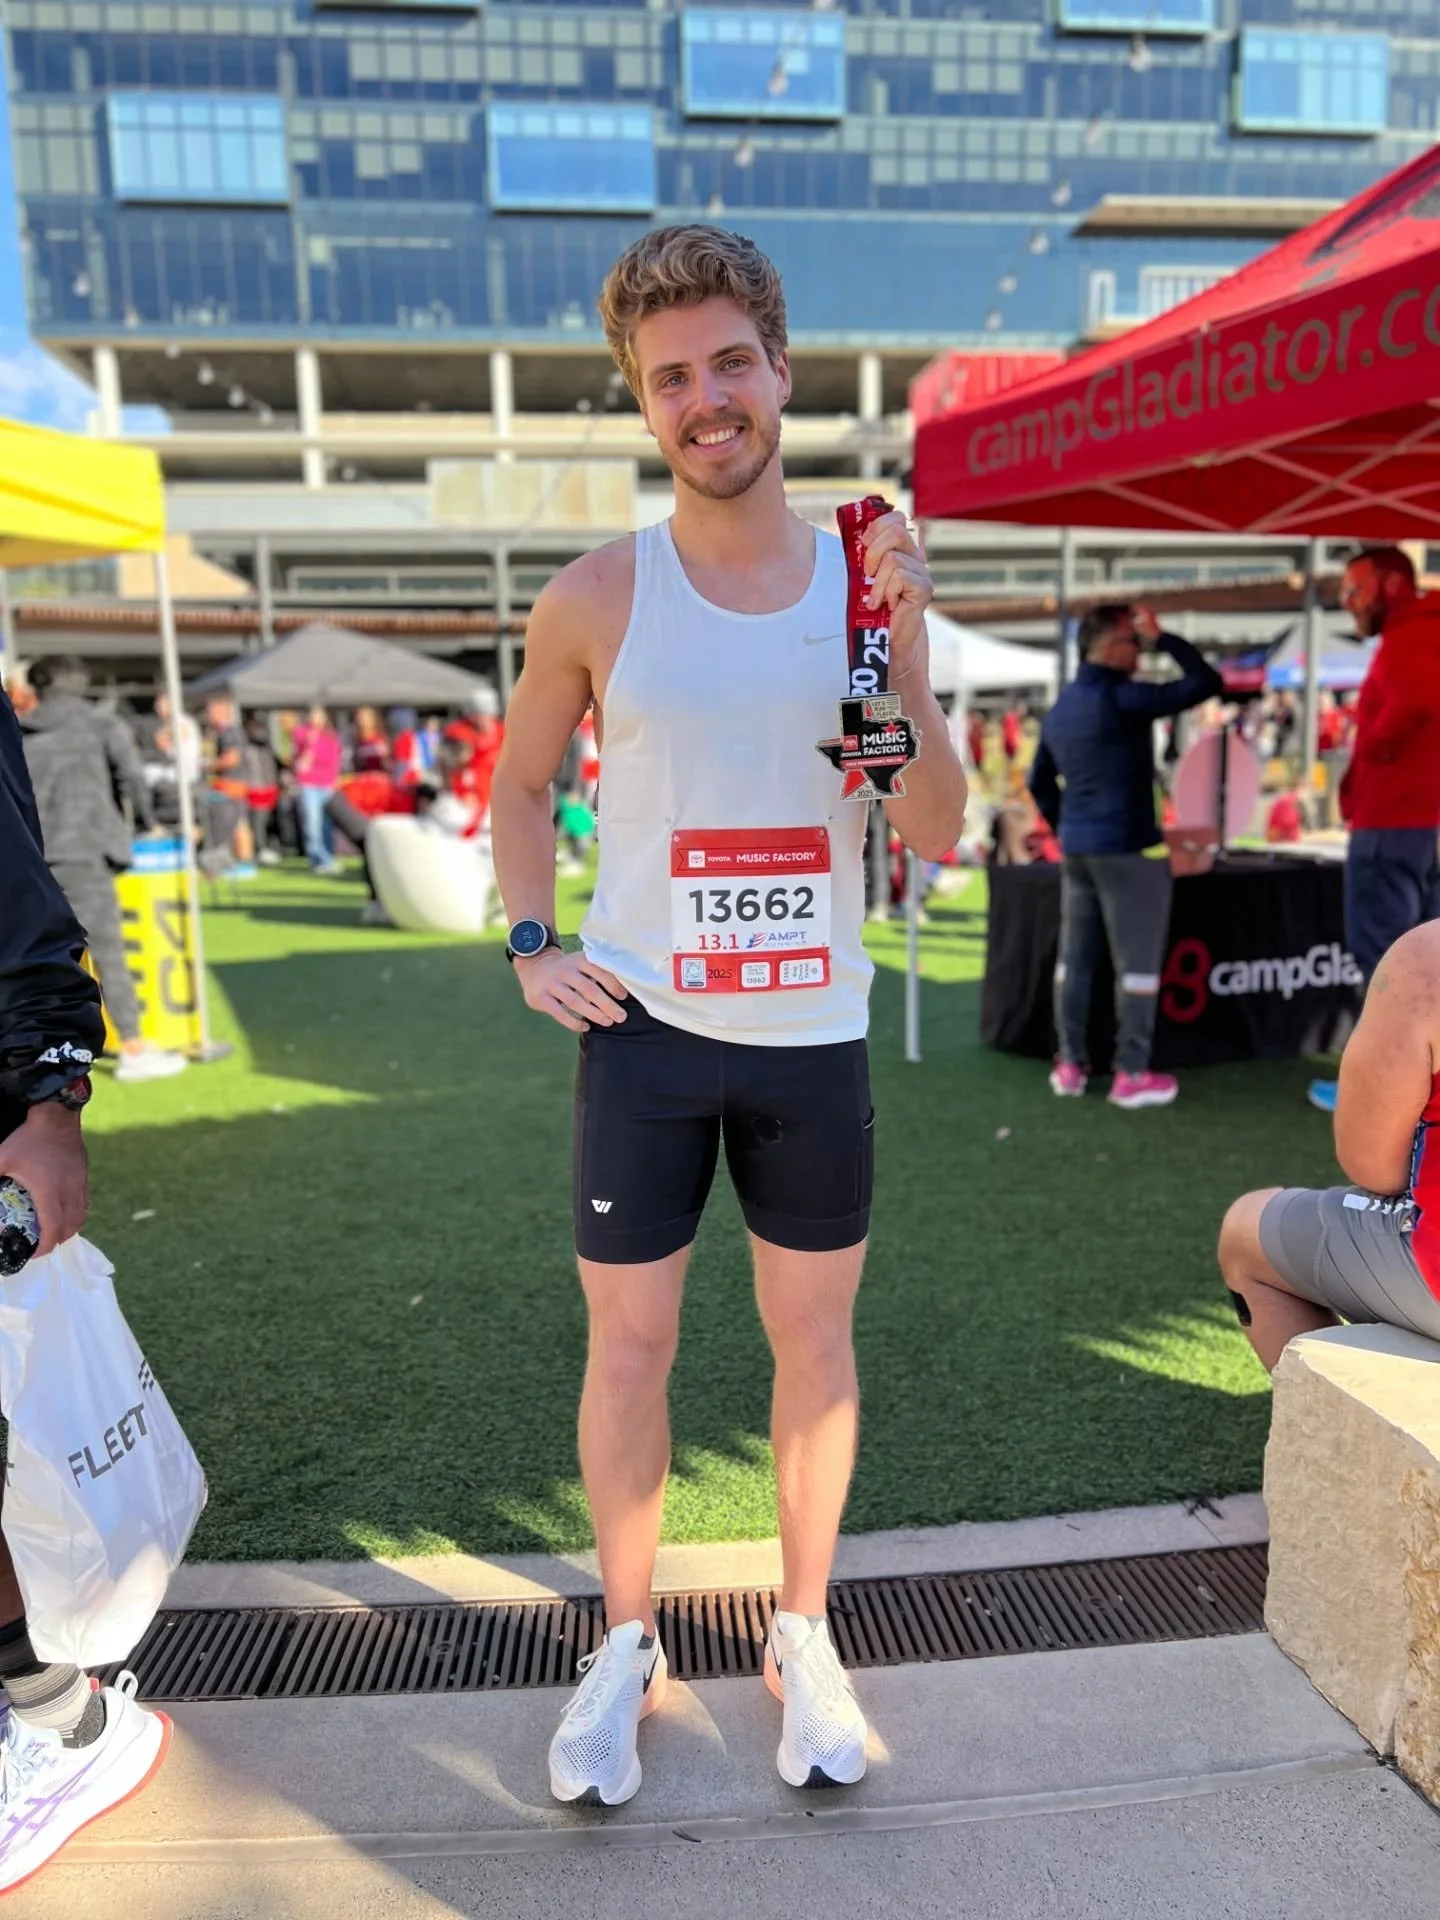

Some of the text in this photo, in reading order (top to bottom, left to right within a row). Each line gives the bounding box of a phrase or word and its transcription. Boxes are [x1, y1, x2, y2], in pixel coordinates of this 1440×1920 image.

[862, 731, 907, 746] MUSIC
[863, 744, 907, 756] FACTORY
[736, 853, 770, 863] MUSIC
[772, 851, 816, 862] FACTORY
[688, 886, 814, 923] 13662
[698, 931, 807, 950] 13.1 AMPT
[707, 968, 733, 979] 2025
[1208, 942, 1364, 1000] campGla
[67, 1402, 148, 1488] FLEET
